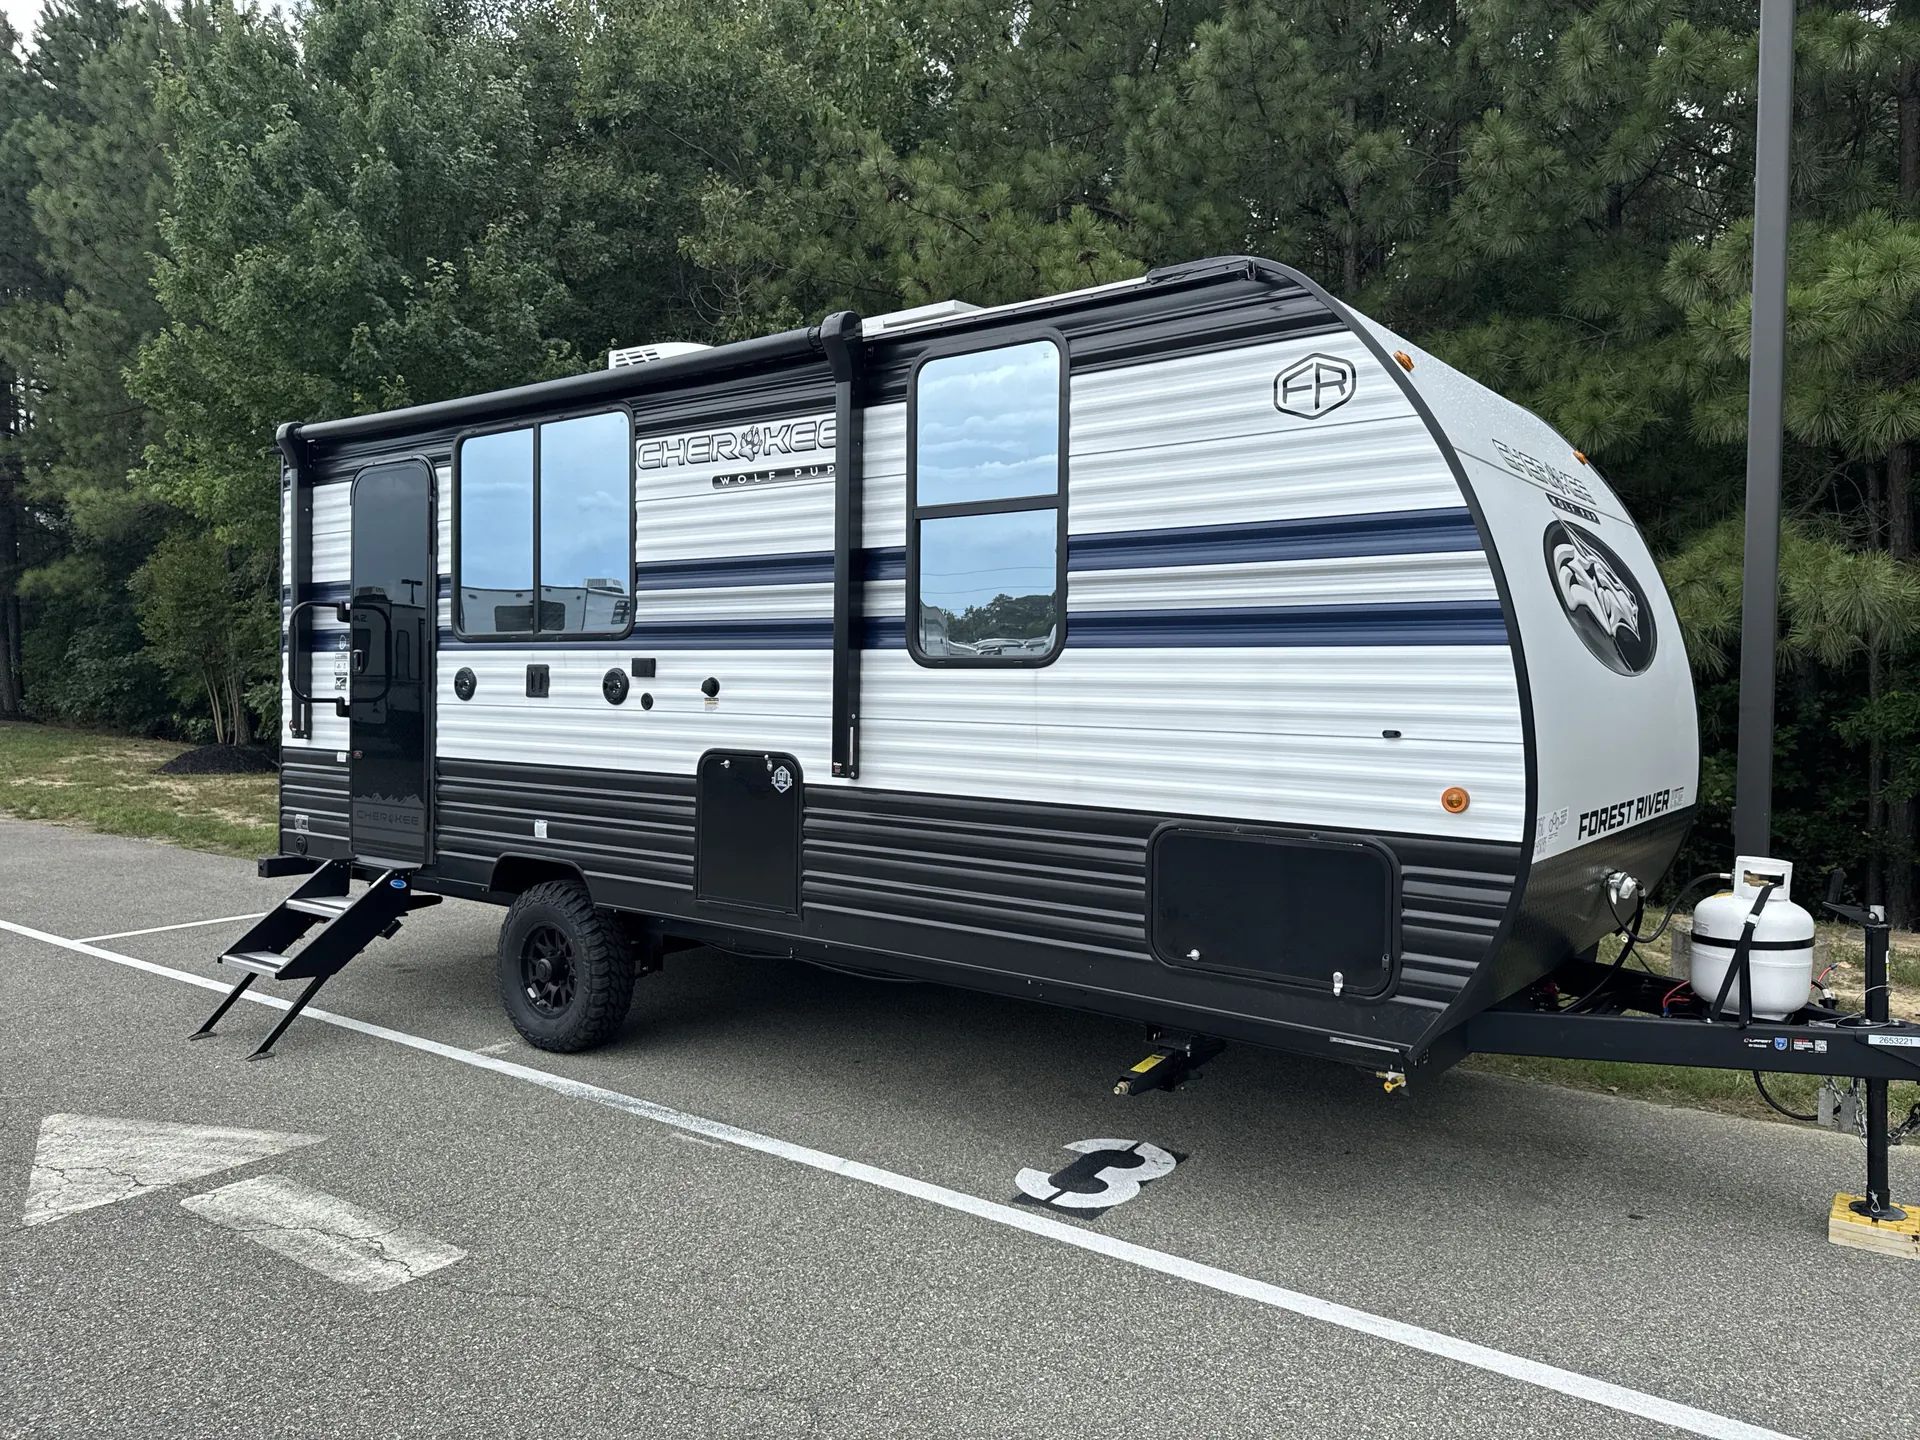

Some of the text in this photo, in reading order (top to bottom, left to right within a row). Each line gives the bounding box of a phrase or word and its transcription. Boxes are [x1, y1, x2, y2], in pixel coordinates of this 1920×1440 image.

[720, 466, 835, 486] WOLF PUP
[1578, 799, 1635, 841] FOREST
[1635, 789, 1670, 821] RIVER
[1878, 1036, 1913, 1045] 2653221
[1015, 1138, 1177, 1208] 3
